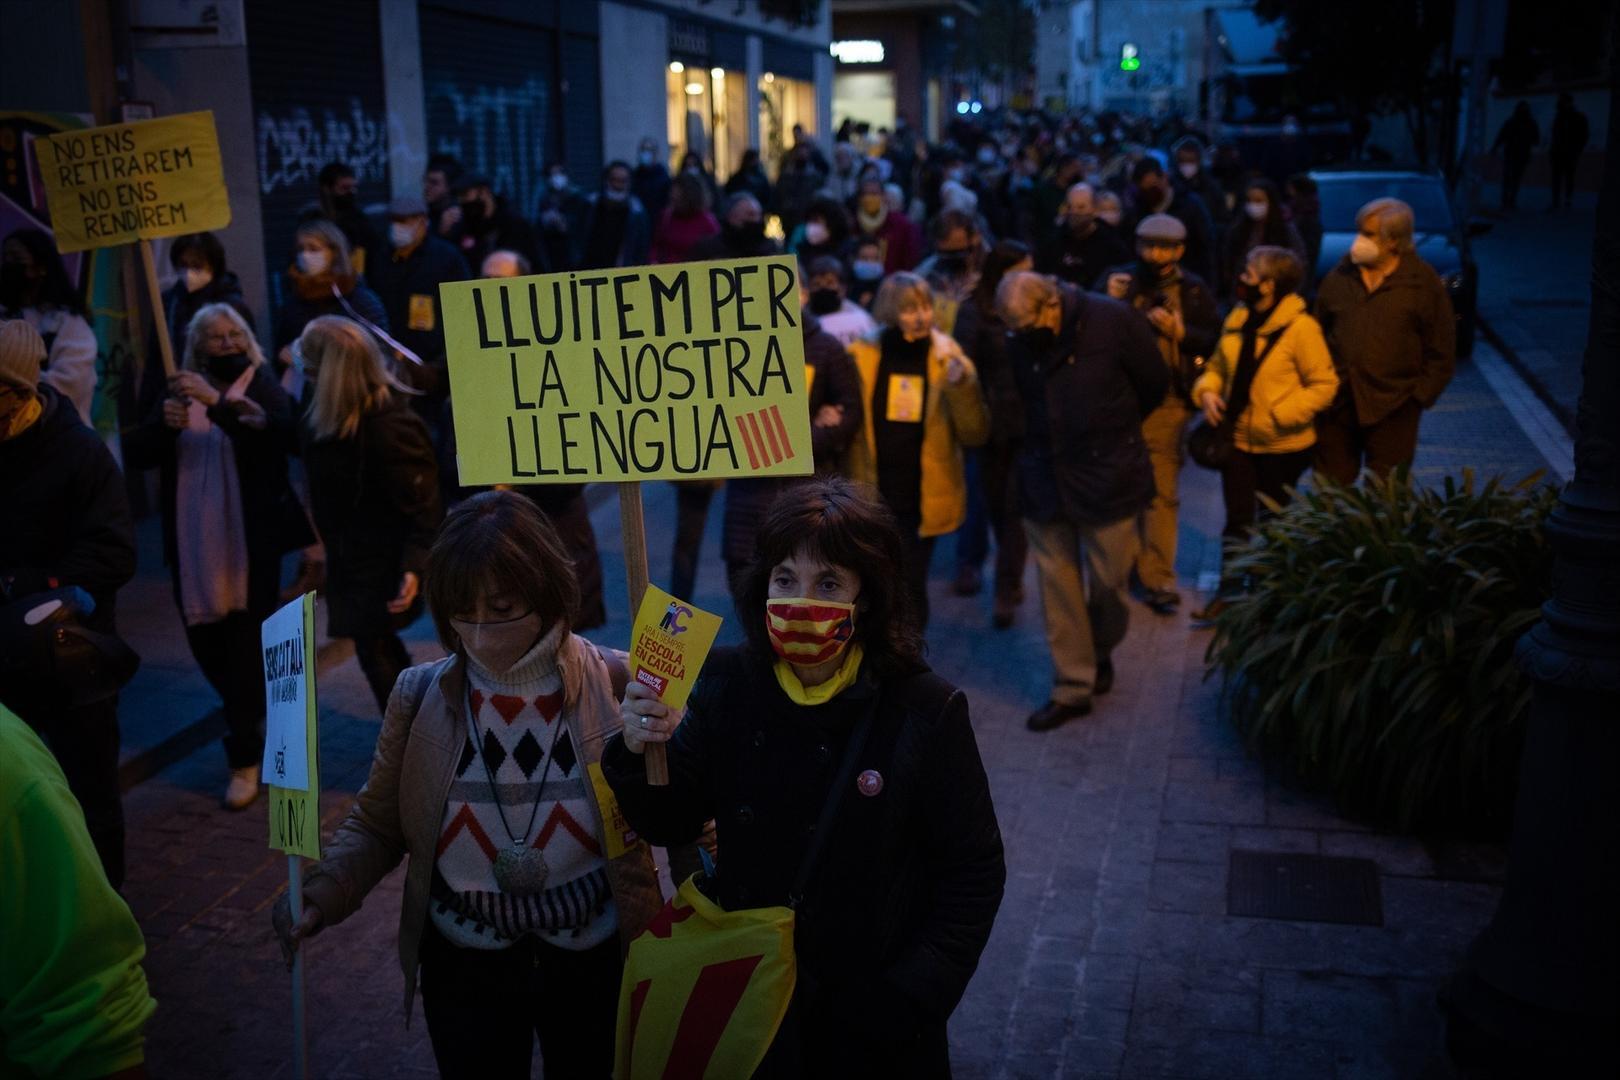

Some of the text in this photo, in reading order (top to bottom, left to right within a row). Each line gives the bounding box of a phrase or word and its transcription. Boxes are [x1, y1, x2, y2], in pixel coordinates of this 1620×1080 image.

[52, 130, 136, 164] NO ENS
[58, 147, 194, 188] RETIRAREM
[78, 181, 158, 214] NO ENS
[709, 264, 797, 333] PER
[510, 335, 793, 410] LA NOSTRA
[507, 404, 740, 477] LLENGUA
[635, 645, 648, 662] EN
[647, 653, 686, 681] CATALÀ
[638, 633, 683, 665] L'ESCOLA
